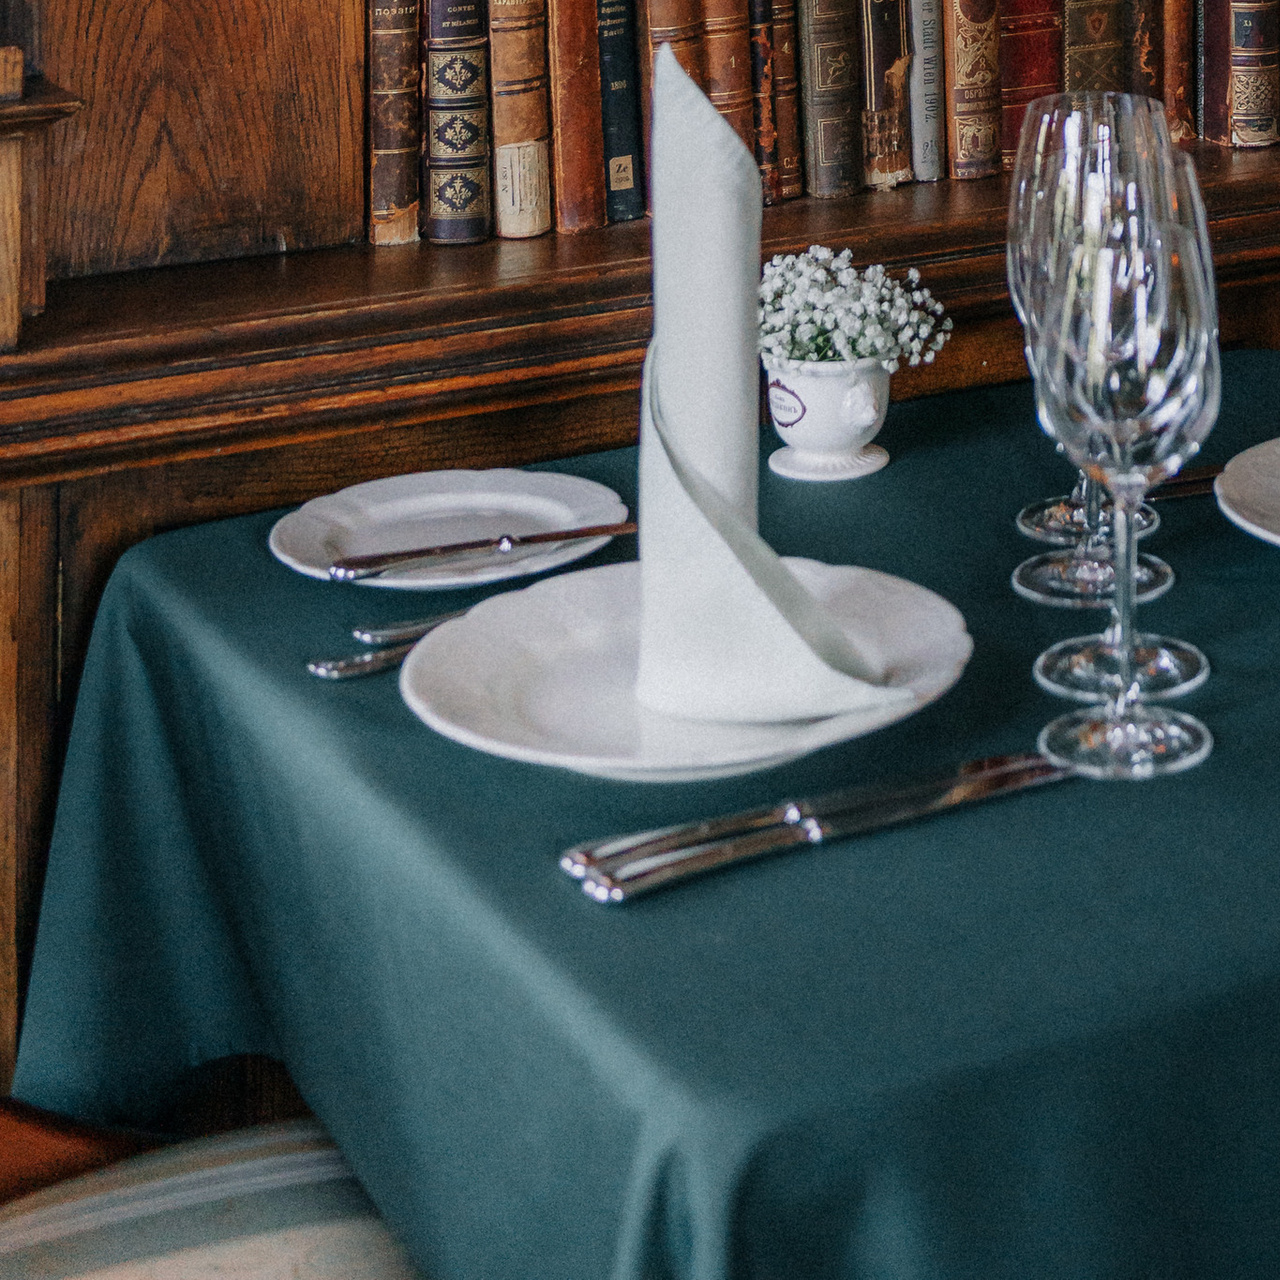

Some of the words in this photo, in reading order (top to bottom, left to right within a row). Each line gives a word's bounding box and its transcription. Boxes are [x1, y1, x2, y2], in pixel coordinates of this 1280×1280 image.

[446, 4, 477, 14] CONTES
[921, 17, 937, 51] Stadt
[923, 52, 938, 88] Wien
